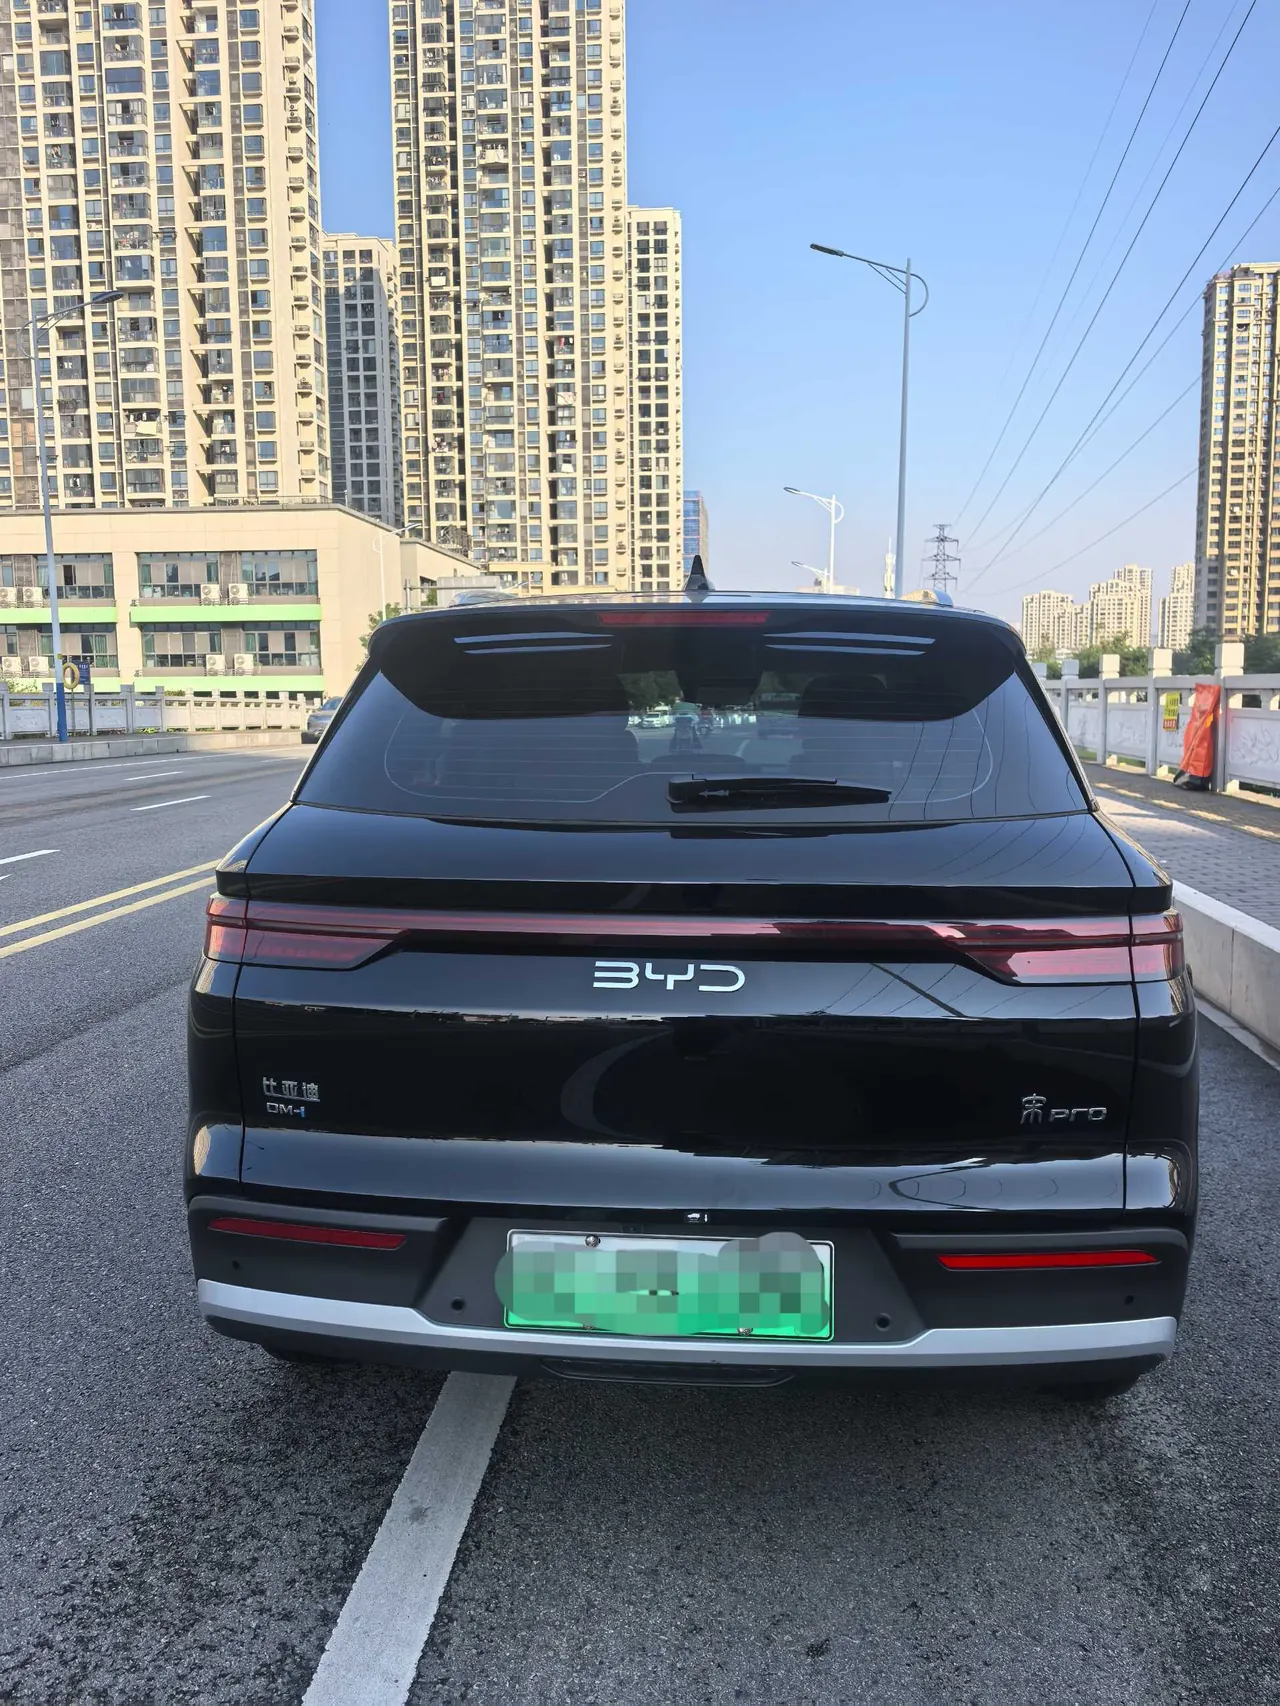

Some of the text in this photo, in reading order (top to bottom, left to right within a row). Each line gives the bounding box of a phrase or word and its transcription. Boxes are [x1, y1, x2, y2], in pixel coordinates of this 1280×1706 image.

[593, 961, 745, 992] BYD
[262, 1076, 321, 1102] 比亚迪
[266, 1102, 306, 1118] DM-i
